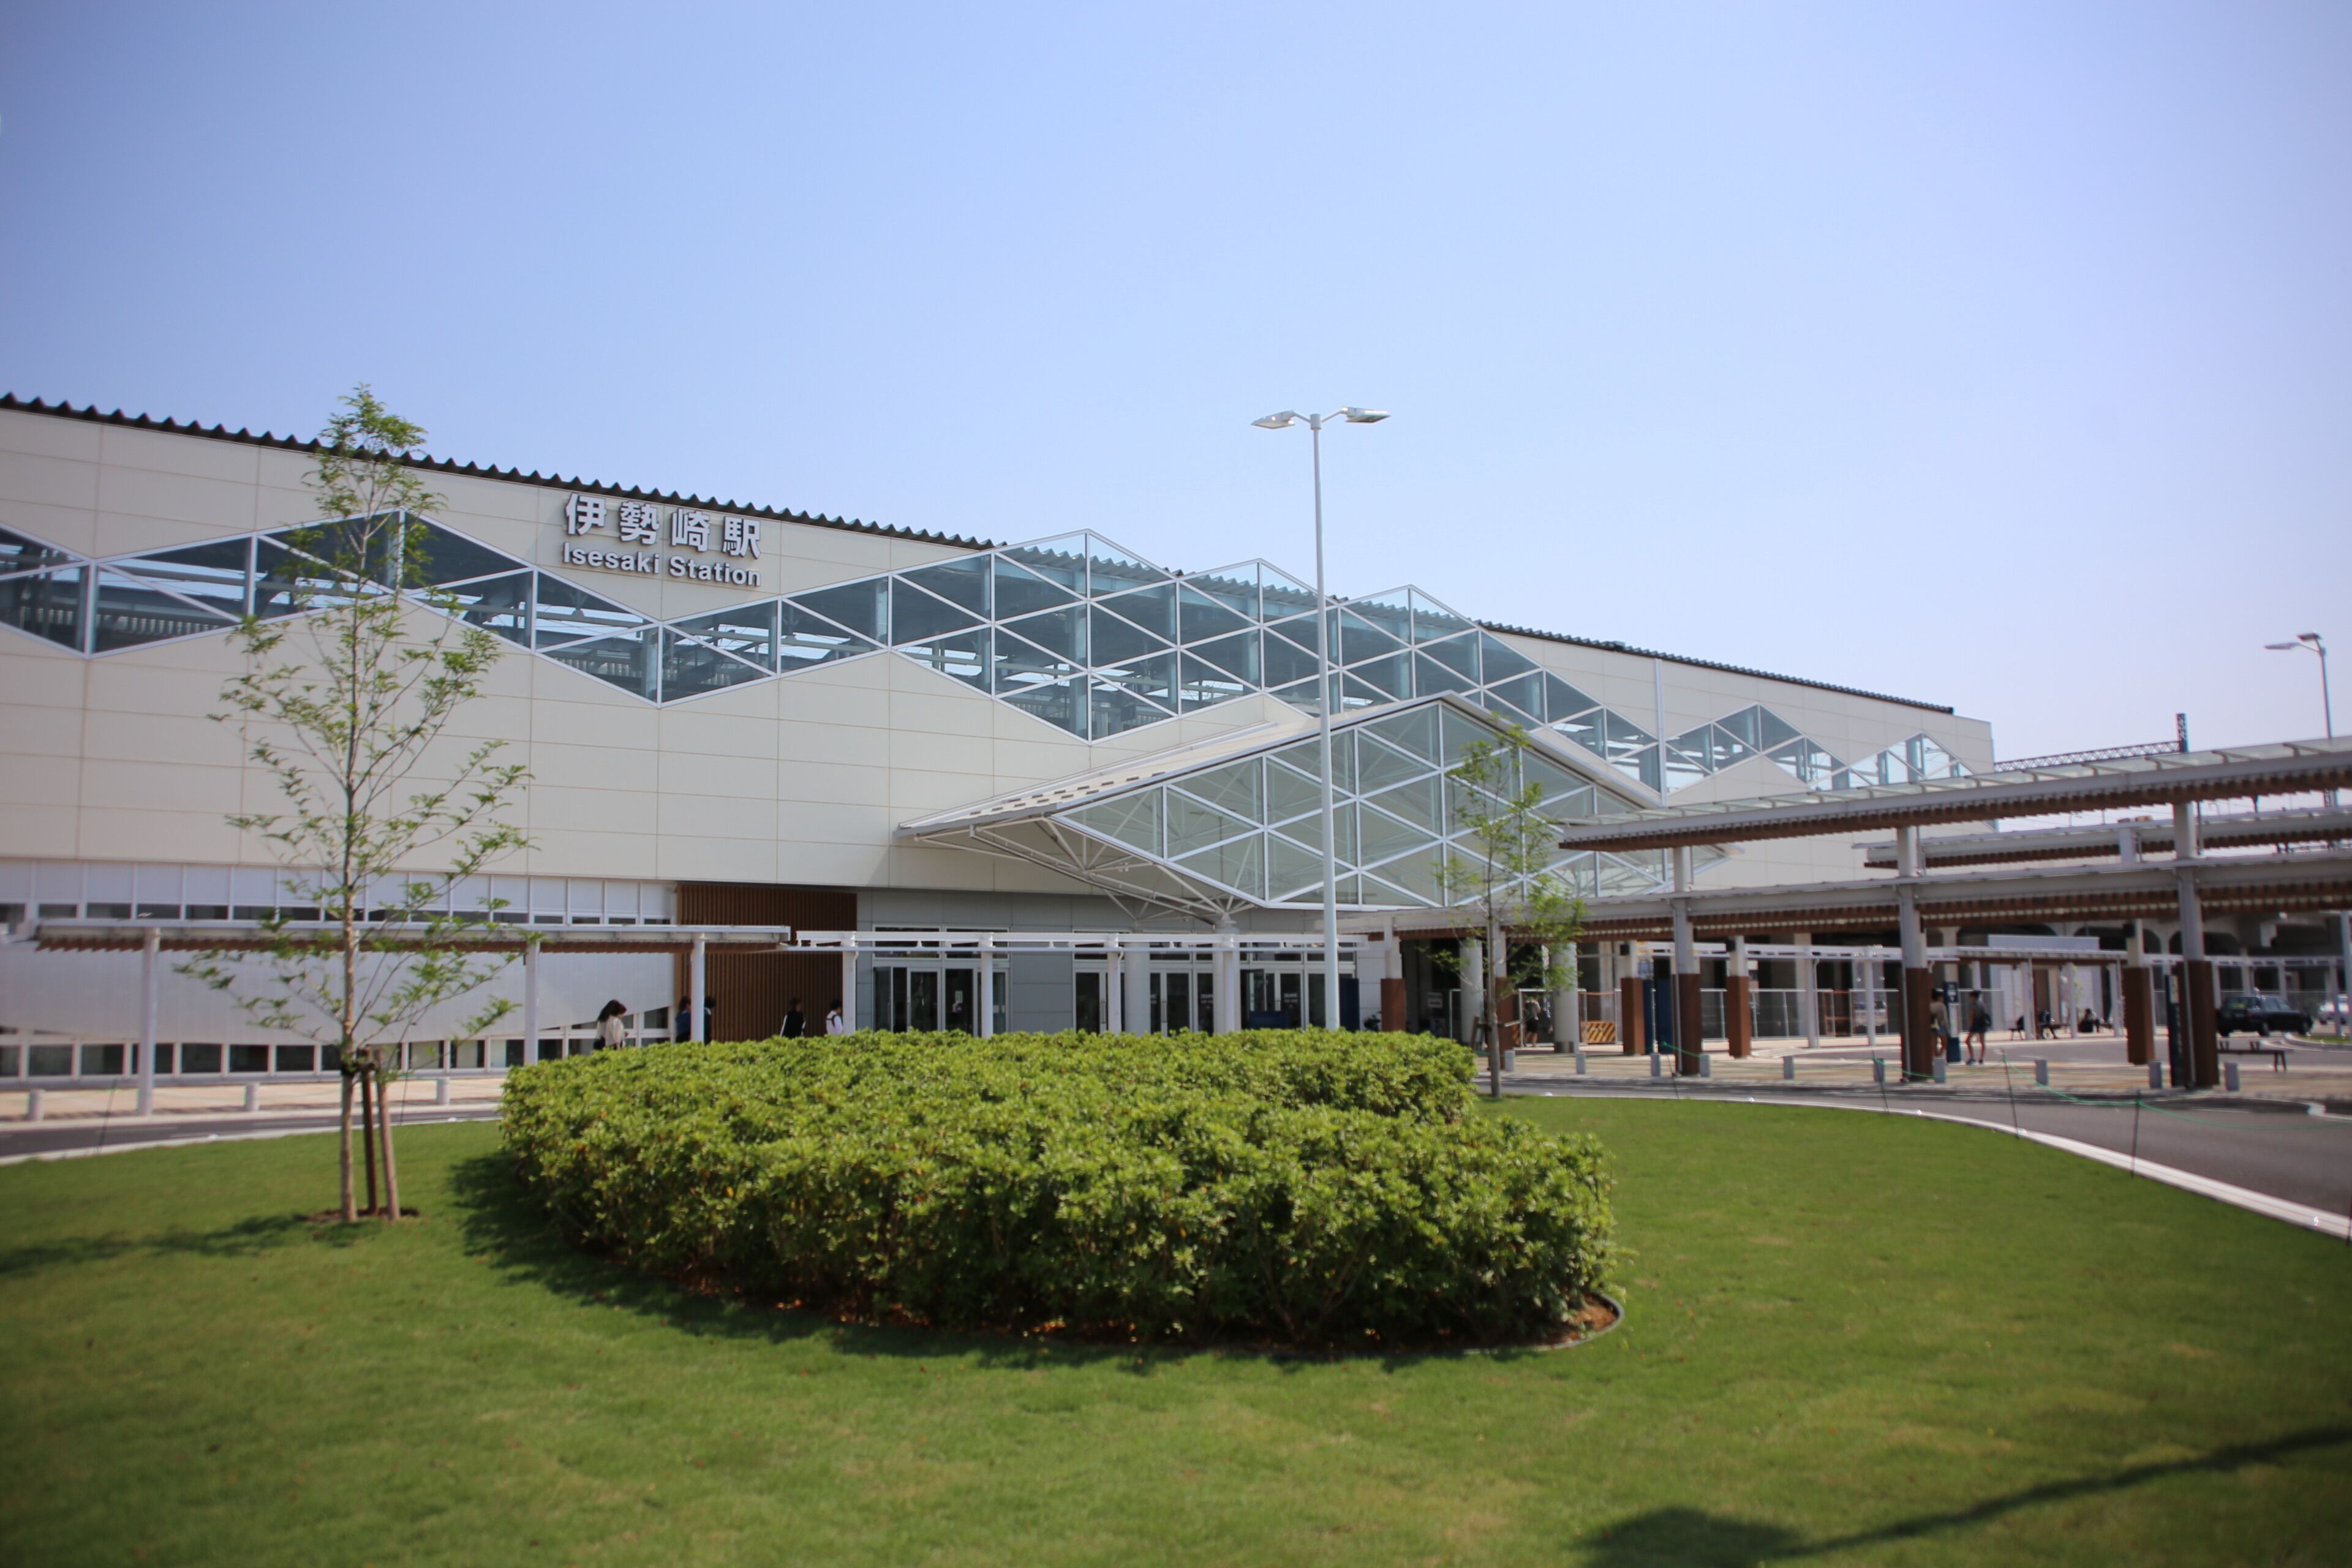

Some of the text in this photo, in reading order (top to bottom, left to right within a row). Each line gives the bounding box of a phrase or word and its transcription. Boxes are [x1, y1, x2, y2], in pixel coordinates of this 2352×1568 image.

[565, 492, 761, 559] 伊勢崎駅
[563, 541, 761, 587] Isesaki Station
